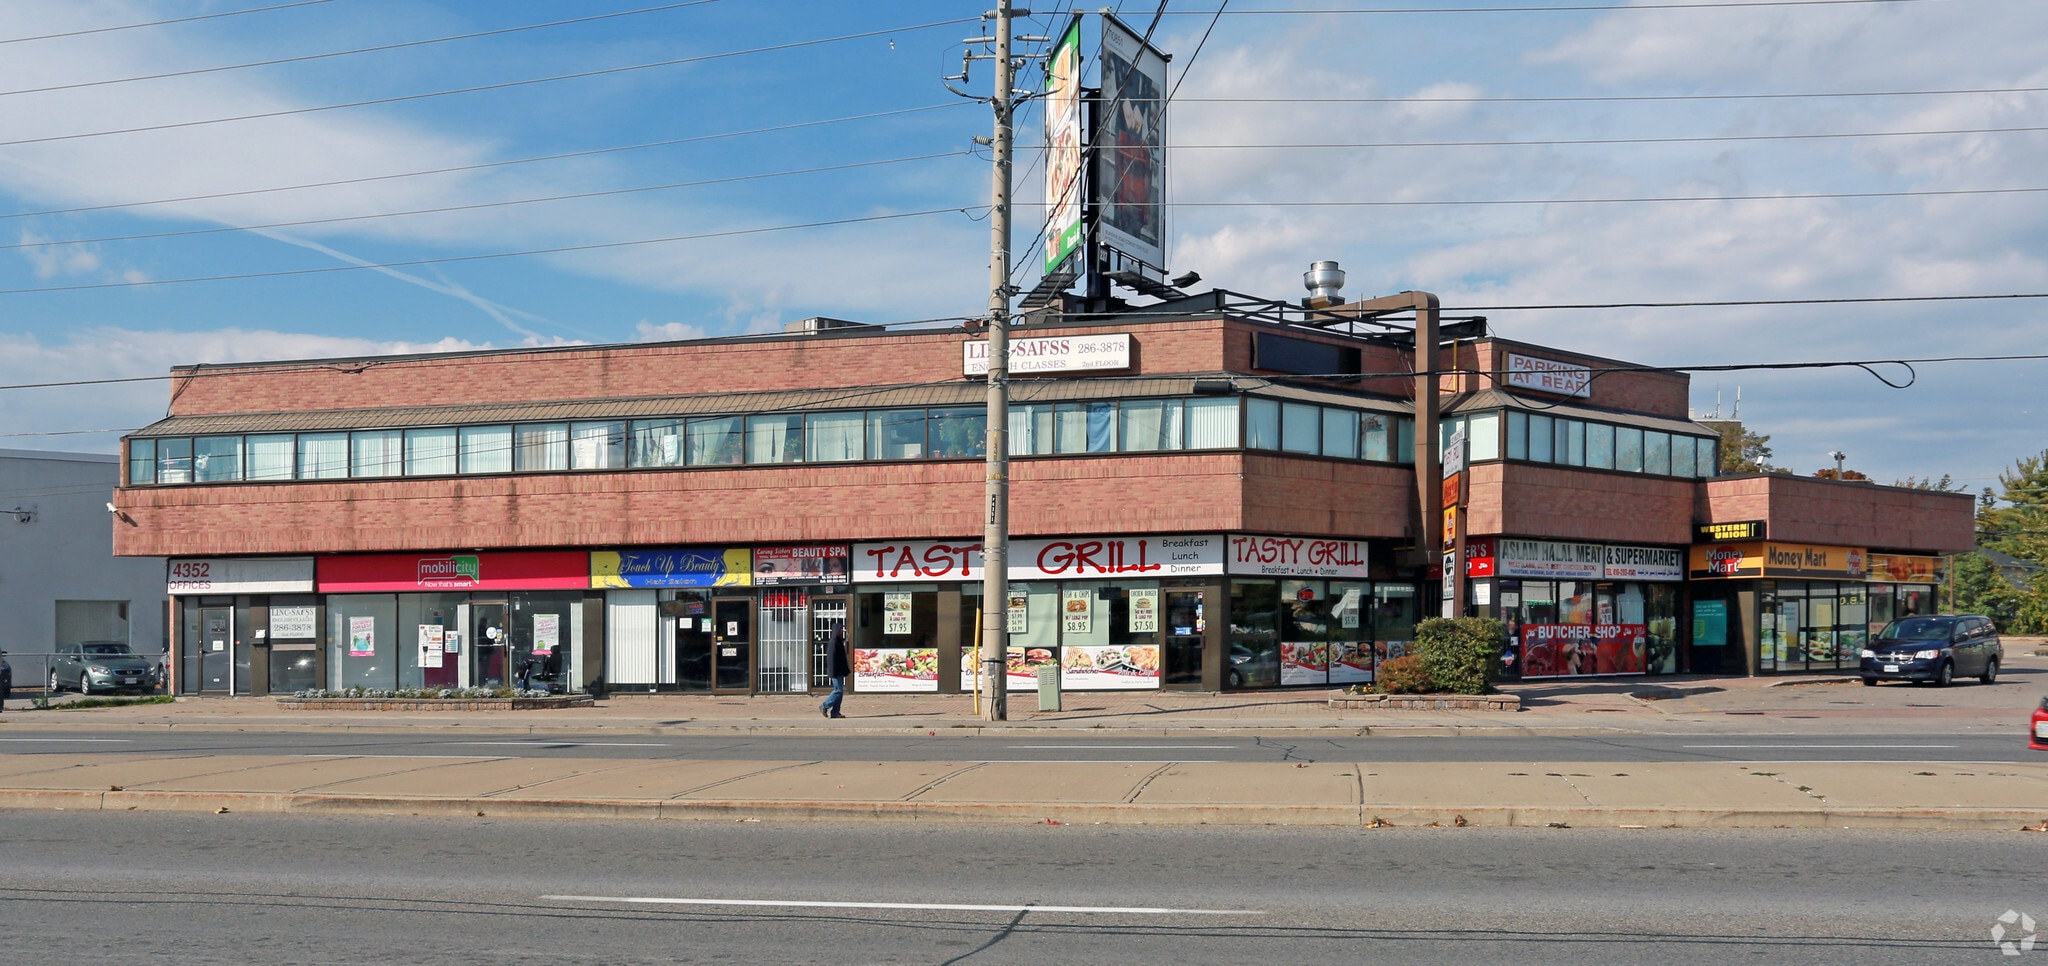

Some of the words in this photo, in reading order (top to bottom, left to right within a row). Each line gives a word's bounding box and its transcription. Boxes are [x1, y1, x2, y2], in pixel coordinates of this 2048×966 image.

[968, 340, 1070, 359] LI-SAFSS
[1078, 342, 1125, 354] 286-3878
[1021, 360, 1066, 370] CLASSES
[1095, 359, 1120, 367] FLOOR
[1514, 357, 1585, 380] PARKING
[1514, 372, 1532, 383] AT
[1542, 375, 1586, 392] REAR
[1701, 523, 1747, 533] WESTERN
[1715, 530, 1747, 539] UNION
[1162, 539, 1209, 548] Breakfast
[792, 547, 828, 558] BEAUTY
[829, 546, 847, 557] SPA
[1037, 540, 1161, 575] GRILL
[1172, 551, 1199, 560] Lunch
[1233, 537, 1304, 564] TASTY
[1308, 541, 1364, 566] GRILL
[1502, 541, 1538, 560] ASLAM
[1542, 543, 1573, 562] HALAL
[1576, 545, 1602, 563] MEAT
[1607, 548, 1613, 565] &
[1615, 548, 1680, 566] SUPERMARKET
[1705, 549, 1744, 563] Money
[1768, 546, 1803, 569] Money
[1805, 548, 1827, 567] Mart
[173, 563, 210, 577] 4352
[421, 561, 476, 576] mobilicity
[623, 555, 651, 574] Touch
[655, 553, 675, 579] Up
[680, 553, 719, 579] Beauty
[1170, 565, 1201, 573] Dinner
[1261, 565, 1290, 574] Breakfast
[1296, 566, 1313, 575] Lunch
[1320, 567, 1338, 575] Dinner
[1708, 560, 1739, 573] Mart
[169, 580, 211, 590] OFFICES
[273, 624, 312, 632] 286-3878
[889, 623, 907, 632] $7.95
[1067, 622, 1086, 631] $8.95
[1134, 621, 1153, 630] $7.50
[1538, 626, 1591, 639] BUTCHER
[1595, 626, 1620, 638] SHOP
